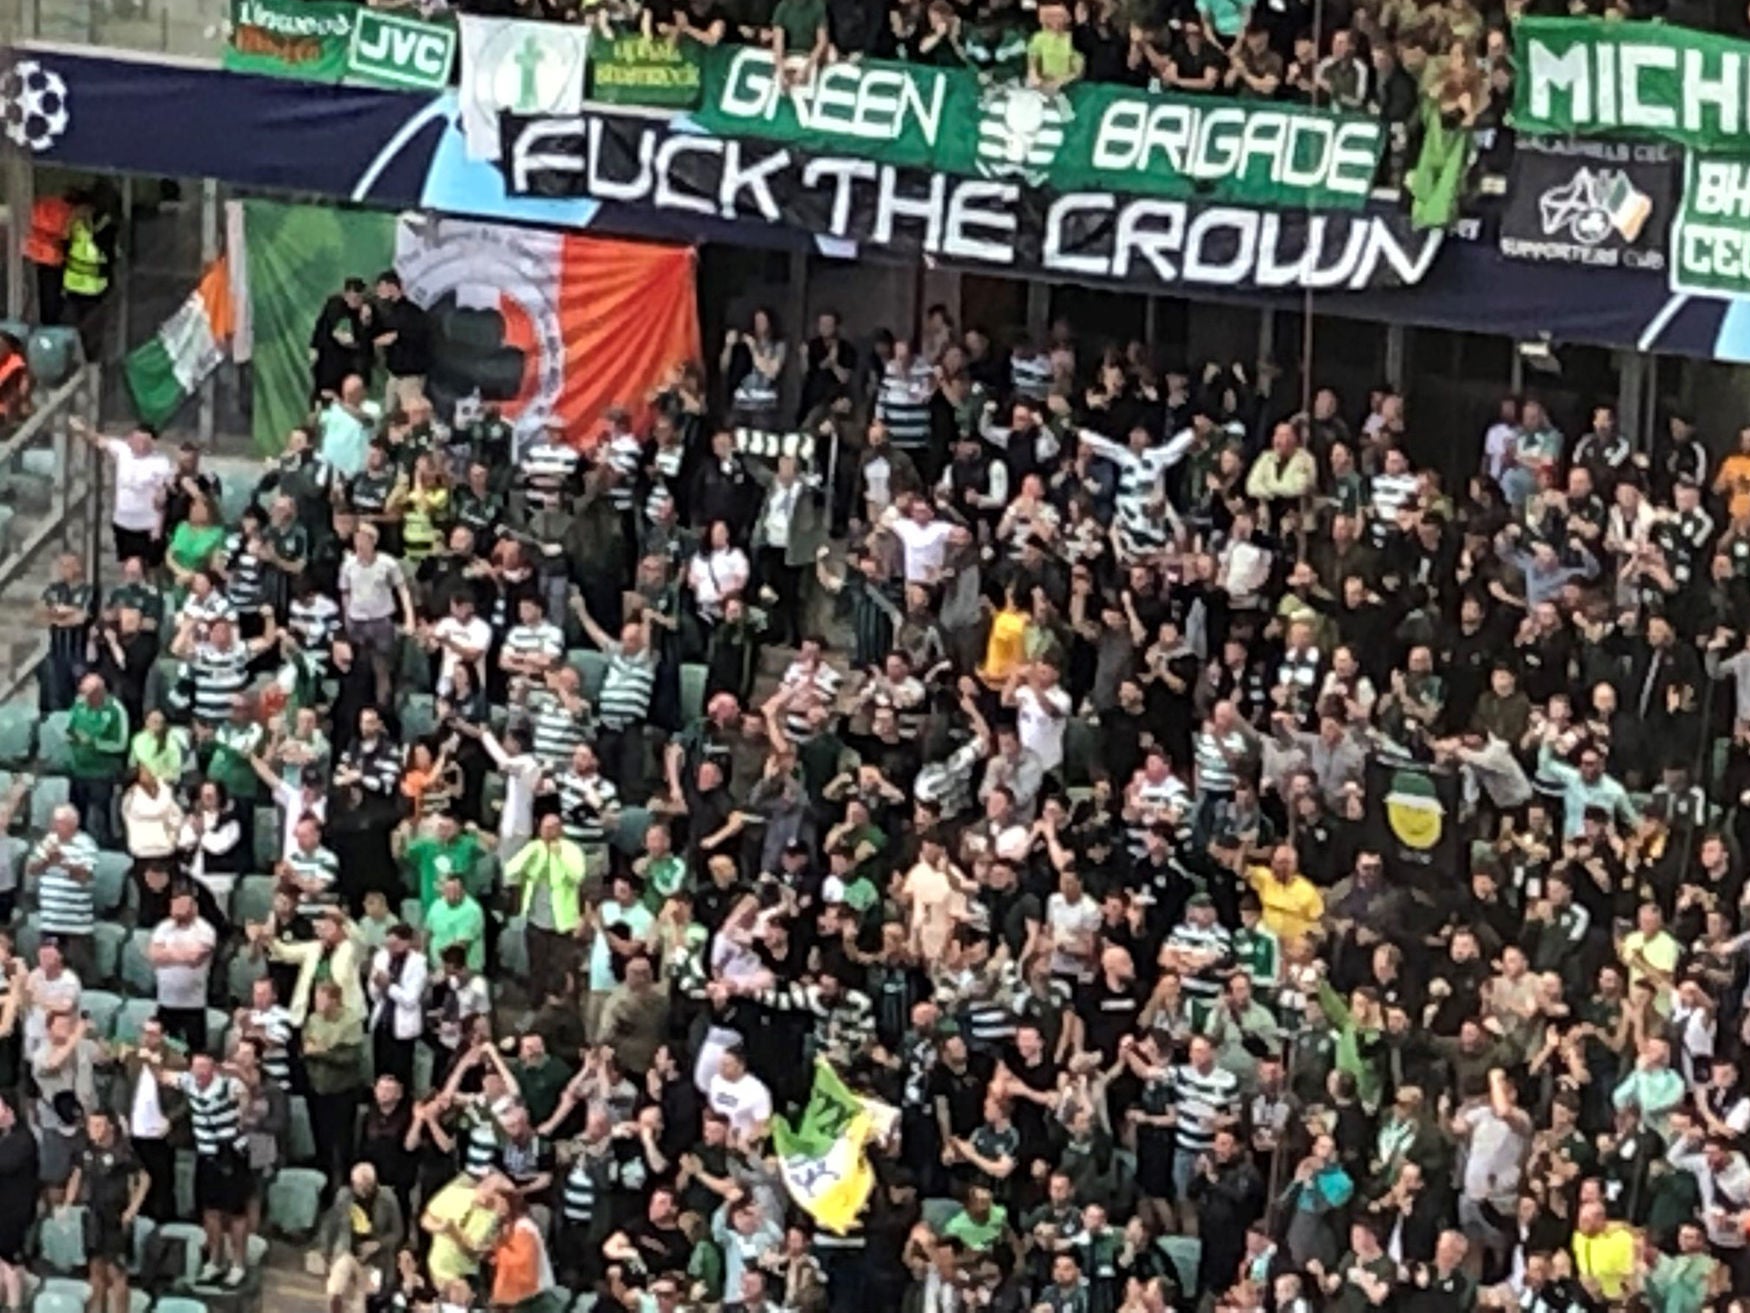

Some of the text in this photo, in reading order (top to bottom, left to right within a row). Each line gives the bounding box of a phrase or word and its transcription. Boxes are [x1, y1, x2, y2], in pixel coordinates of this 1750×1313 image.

[360, 25, 447, 74] JVC
[719, 47, 1382, 194] GREEN BRIGADE
[512, 117, 1444, 289] FUCK THE CROWN
